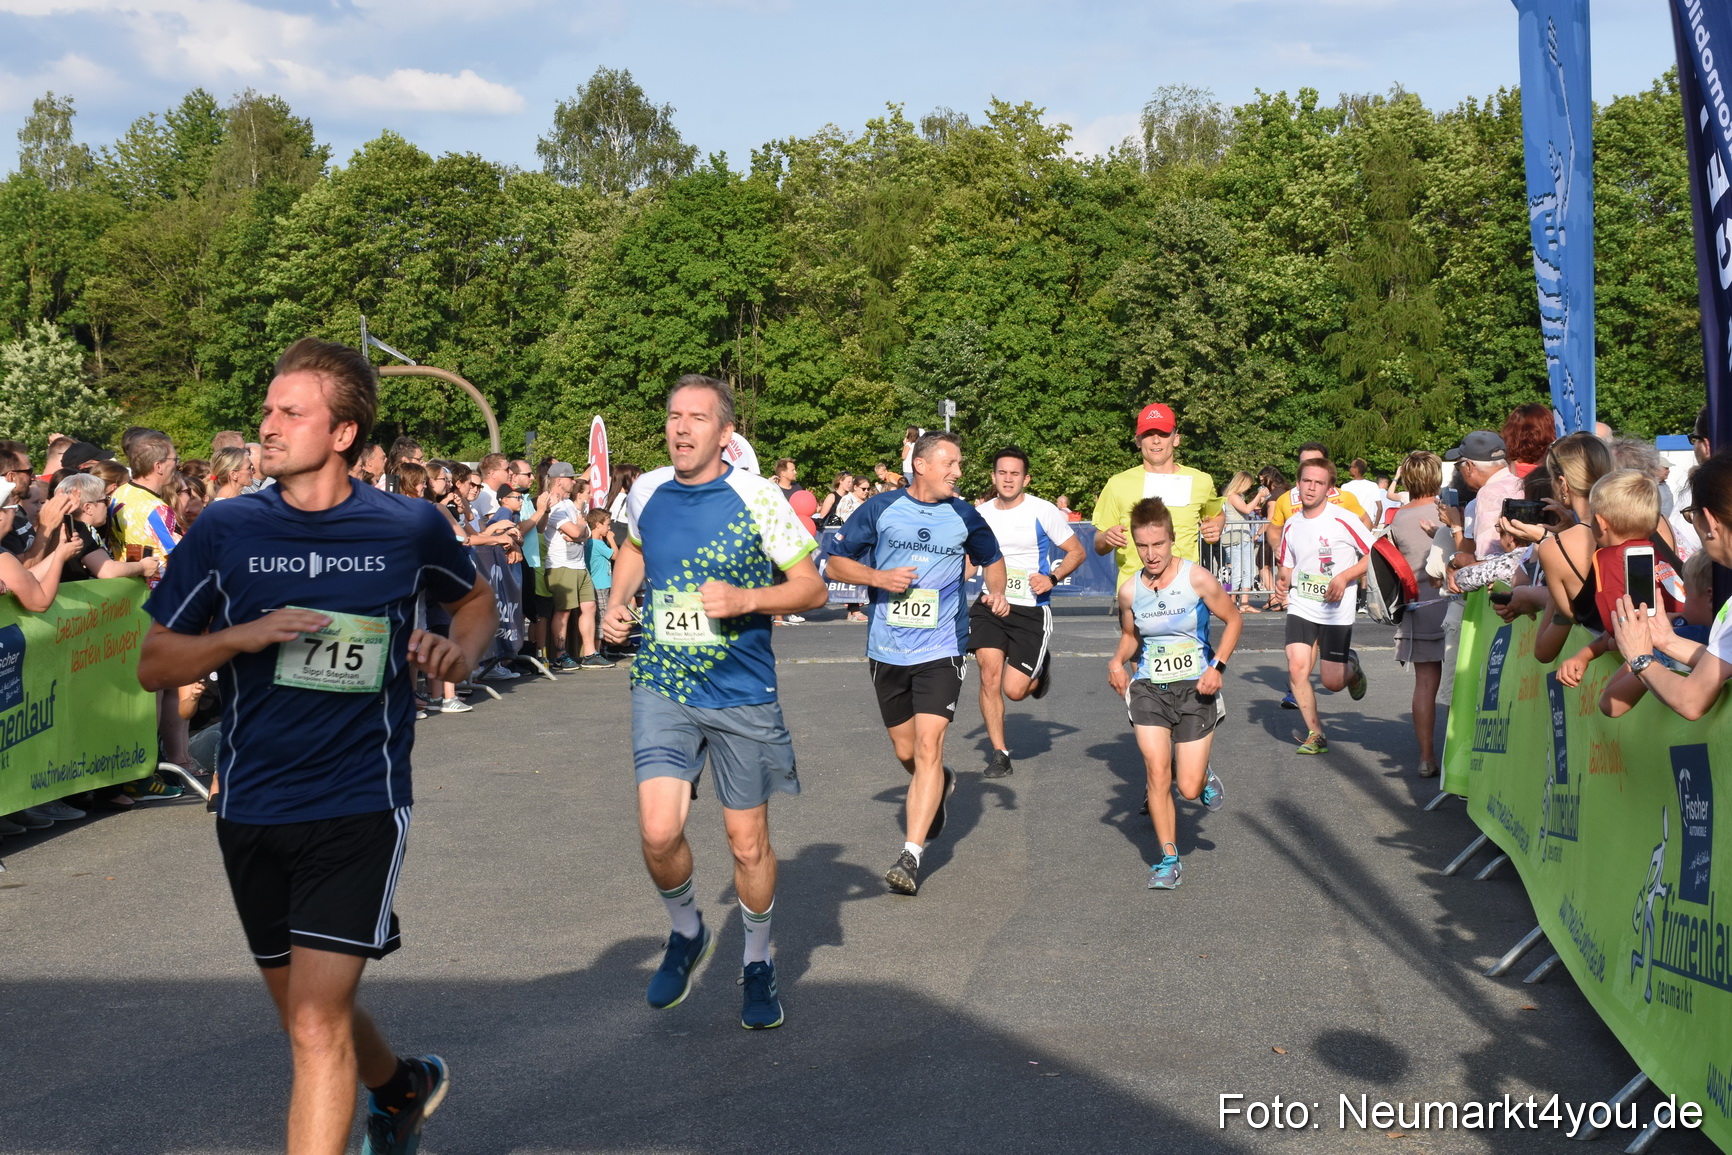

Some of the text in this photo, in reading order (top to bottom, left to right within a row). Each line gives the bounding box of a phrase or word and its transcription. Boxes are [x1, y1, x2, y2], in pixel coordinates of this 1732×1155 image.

[249, 556, 385, 573] EURO POLES
[911, 554, 929, 563] TEAM
[1301, 581, 1327, 595] 1786
[892, 600, 931, 617] 2102
[665, 611, 699, 630] 241
[103, 619, 141, 664] länger!
[304, 637, 364, 671] 715
[1154, 654, 1193, 673] 2108
[326, 669, 360, 680] Stephan
[1684, 793, 1709, 820] Fischer
[1656, 979, 1693, 1015] neumarkt
